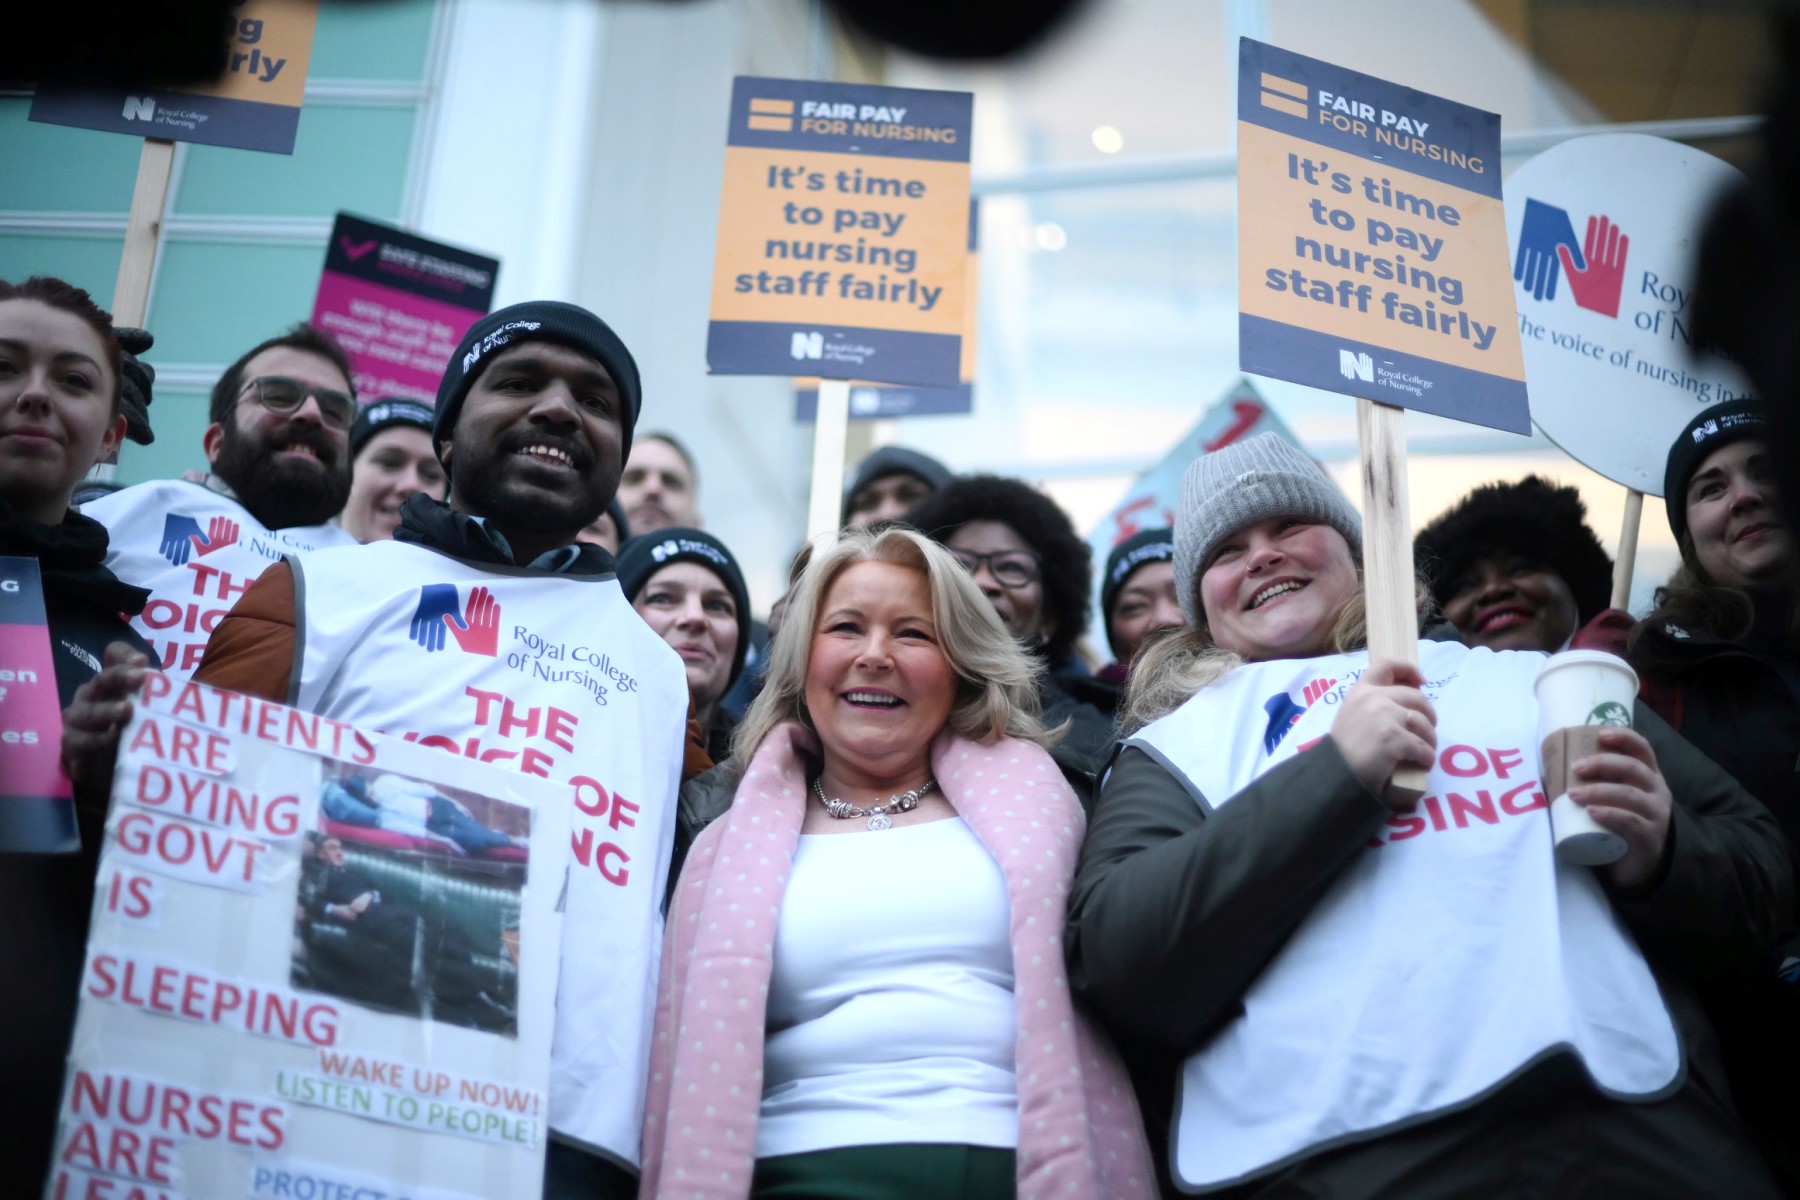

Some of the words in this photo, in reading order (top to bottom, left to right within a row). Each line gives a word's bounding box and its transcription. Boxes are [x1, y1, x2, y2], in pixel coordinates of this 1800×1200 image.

[801, 101, 857, 120] FAIR
[860, 105, 907, 123] PAY
[801, 118, 848, 136] FOR
[853, 123, 957, 144] NURSING
[1318, 90, 1376, 123] FAIR
[1381, 109, 1430, 139] PAY
[1319, 109, 1368, 139] FOR
[1375, 127, 1484, 174] NURSING
[767, 165, 826, 191] It’s
[836, 169, 927, 198] time
[1288, 152, 1353, 195] It’s
[1361, 176, 1462, 227] time
[783, 202, 824, 226] to
[834, 209, 906, 238] pay
[1309, 198, 1356, 232] to
[1367, 218, 1444, 262] pay
[765, 238, 918, 274] nursing
[1295, 235, 1464, 305] nursing
[734, 271, 831, 296] staff
[838, 273, 943, 312] fairly
[1265, 268, 1373, 313] staff
[1381, 292, 1497, 351] fairly
[1641, 271, 1692, 312] Roy
[483, 343, 493, 353] of
[484, 325, 504, 343] Royal
[505, 320, 541, 331] College
[1634, 311, 1666, 335] of
[1378, 367, 1401, 382] Royal
[1403, 373, 1433, 388] College
[1378, 377, 1389, 386] of
[1389, 379, 1422, 396] Nursing
[1551, 330, 1604, 359] voice
[1610, 350, 1633, 369] of
[1636, 359, 1711, 403] nursing
[1716, 383, 1734, 401] in
[187, 562, 255, 600] TH
[507, 653, 529, 672] of
[533, 661, 608, 706] Nursing
[513, 626, 565, 661] Royal
[571, 647, 638, 692] College
[141, 672, 376, 764] PATIENTS
[465, 685, 579, 754] THE
[130, 719, 230, 774] ARE
[1439, 744, 1524, 780] OF
[137, 765, 300, 836] DYING
[567, 775, 640, 832] OF
[1367, 781, 1549, 848] SING
[116, 812, 267, 882] GOVT
[108, 871, 153, 919] IS
[88, 954, 339, 1047] SLEEPING
[71, 1070, 285, 1151] NURSES
[276, 1071, 372, 1112] LISTEN
[383, 1092, 418, 1121] TO
[428, 1103, 539, 1146] PEOPLE!
[319, 1050, 404, 1088] WAKE
[413, 1069, 450, 1097] UP
[460, 1079, 539, 1116] NOW!
[62, 1121, 175, 1184] ARE
